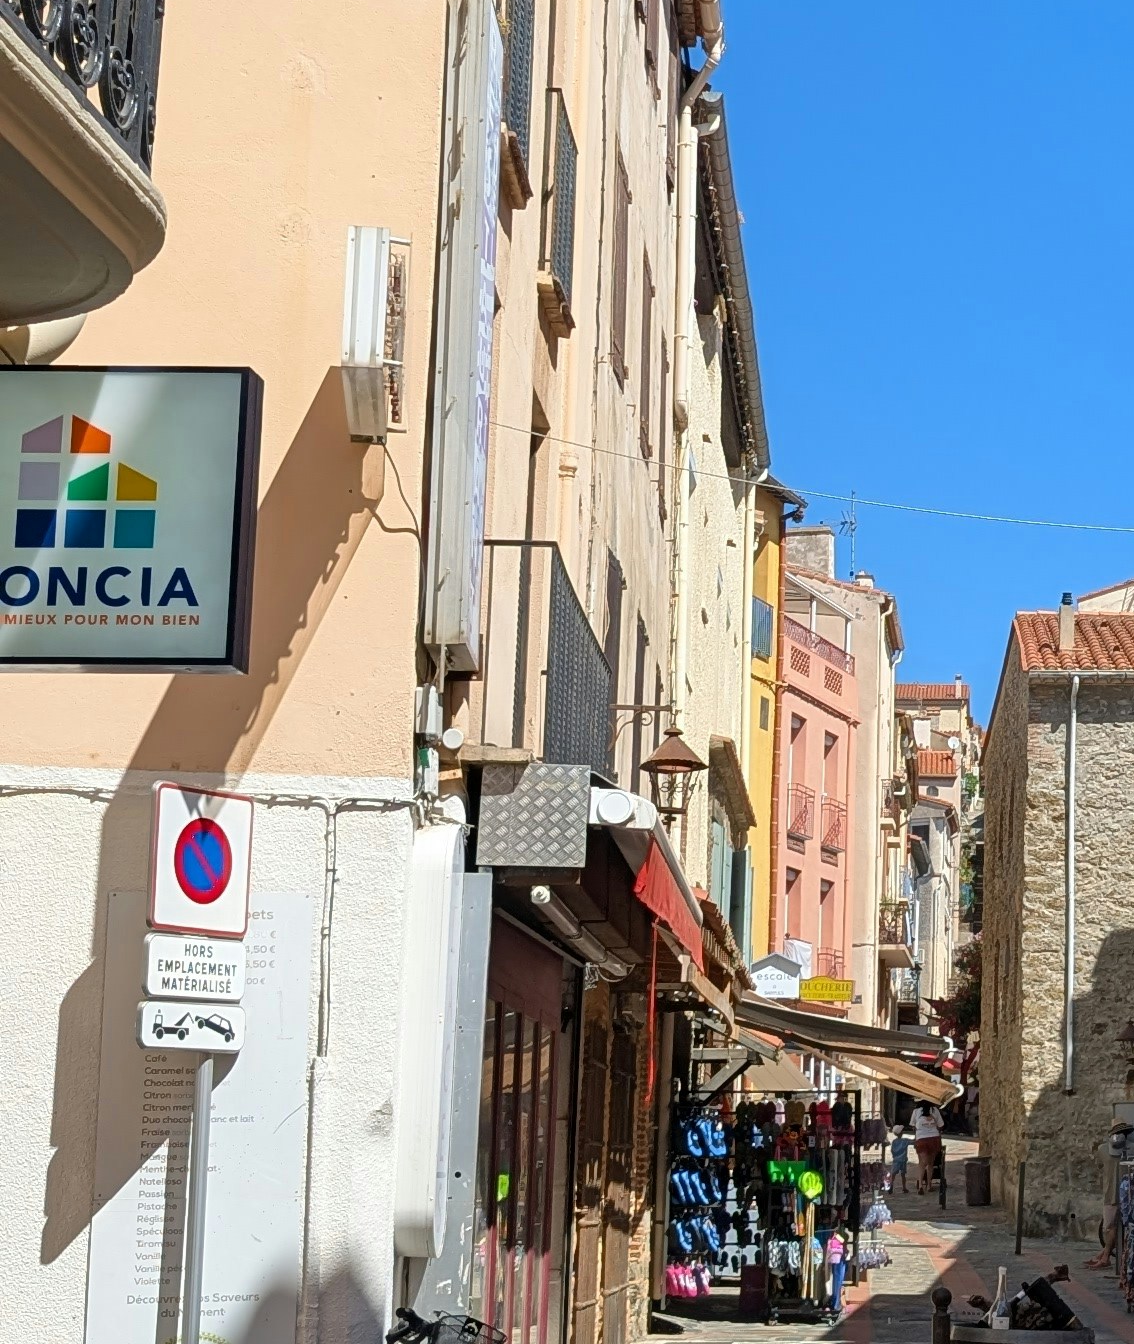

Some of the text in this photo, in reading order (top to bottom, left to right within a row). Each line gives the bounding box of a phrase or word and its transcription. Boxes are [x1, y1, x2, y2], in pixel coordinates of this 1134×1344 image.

[4, 614, 200, 626] MIEUX POUR MON BIEN
[184, 943, 214, 959] HORS
[157, 959, 238, 977] EMPLACEMENT
[161, 975, 232, 994] MATÉRIALISÉ
[800, 982, 853, 992] OUCHERIE
[144, 1054, 168, 1063] Café
[144, 1067, 184, 1075] Caramel
[143, 1079, 185, 1087] Chocolat
[143, 1091, 172, 1099] Citron
[142, 1103, 171, 1112] Citron
[142, 1116, 161, 1124] Duo
[229, 1115, 239, 1123] et
[240, 1114, 255, 1123] lait
[141, 1128, 171, 1136] Fraise
[138, 1190, 175, 1198] Passion
[137, 1202, 178, 1211] Pistache
[136, 1214, 175, 1225] Réglisse
[136, 1227, 184, 1237] Spéculoos
[135, 1239, 177, 1248] Tiramisu
[135, 1252, 167, 1261] Vanille
[134, 1264, 165, 1273] Vanille
[133, 1277, 171, 1286] Violette
[212, 1292, 260, 1303] Saveurs
[160, 1308, 176, 1318] du
